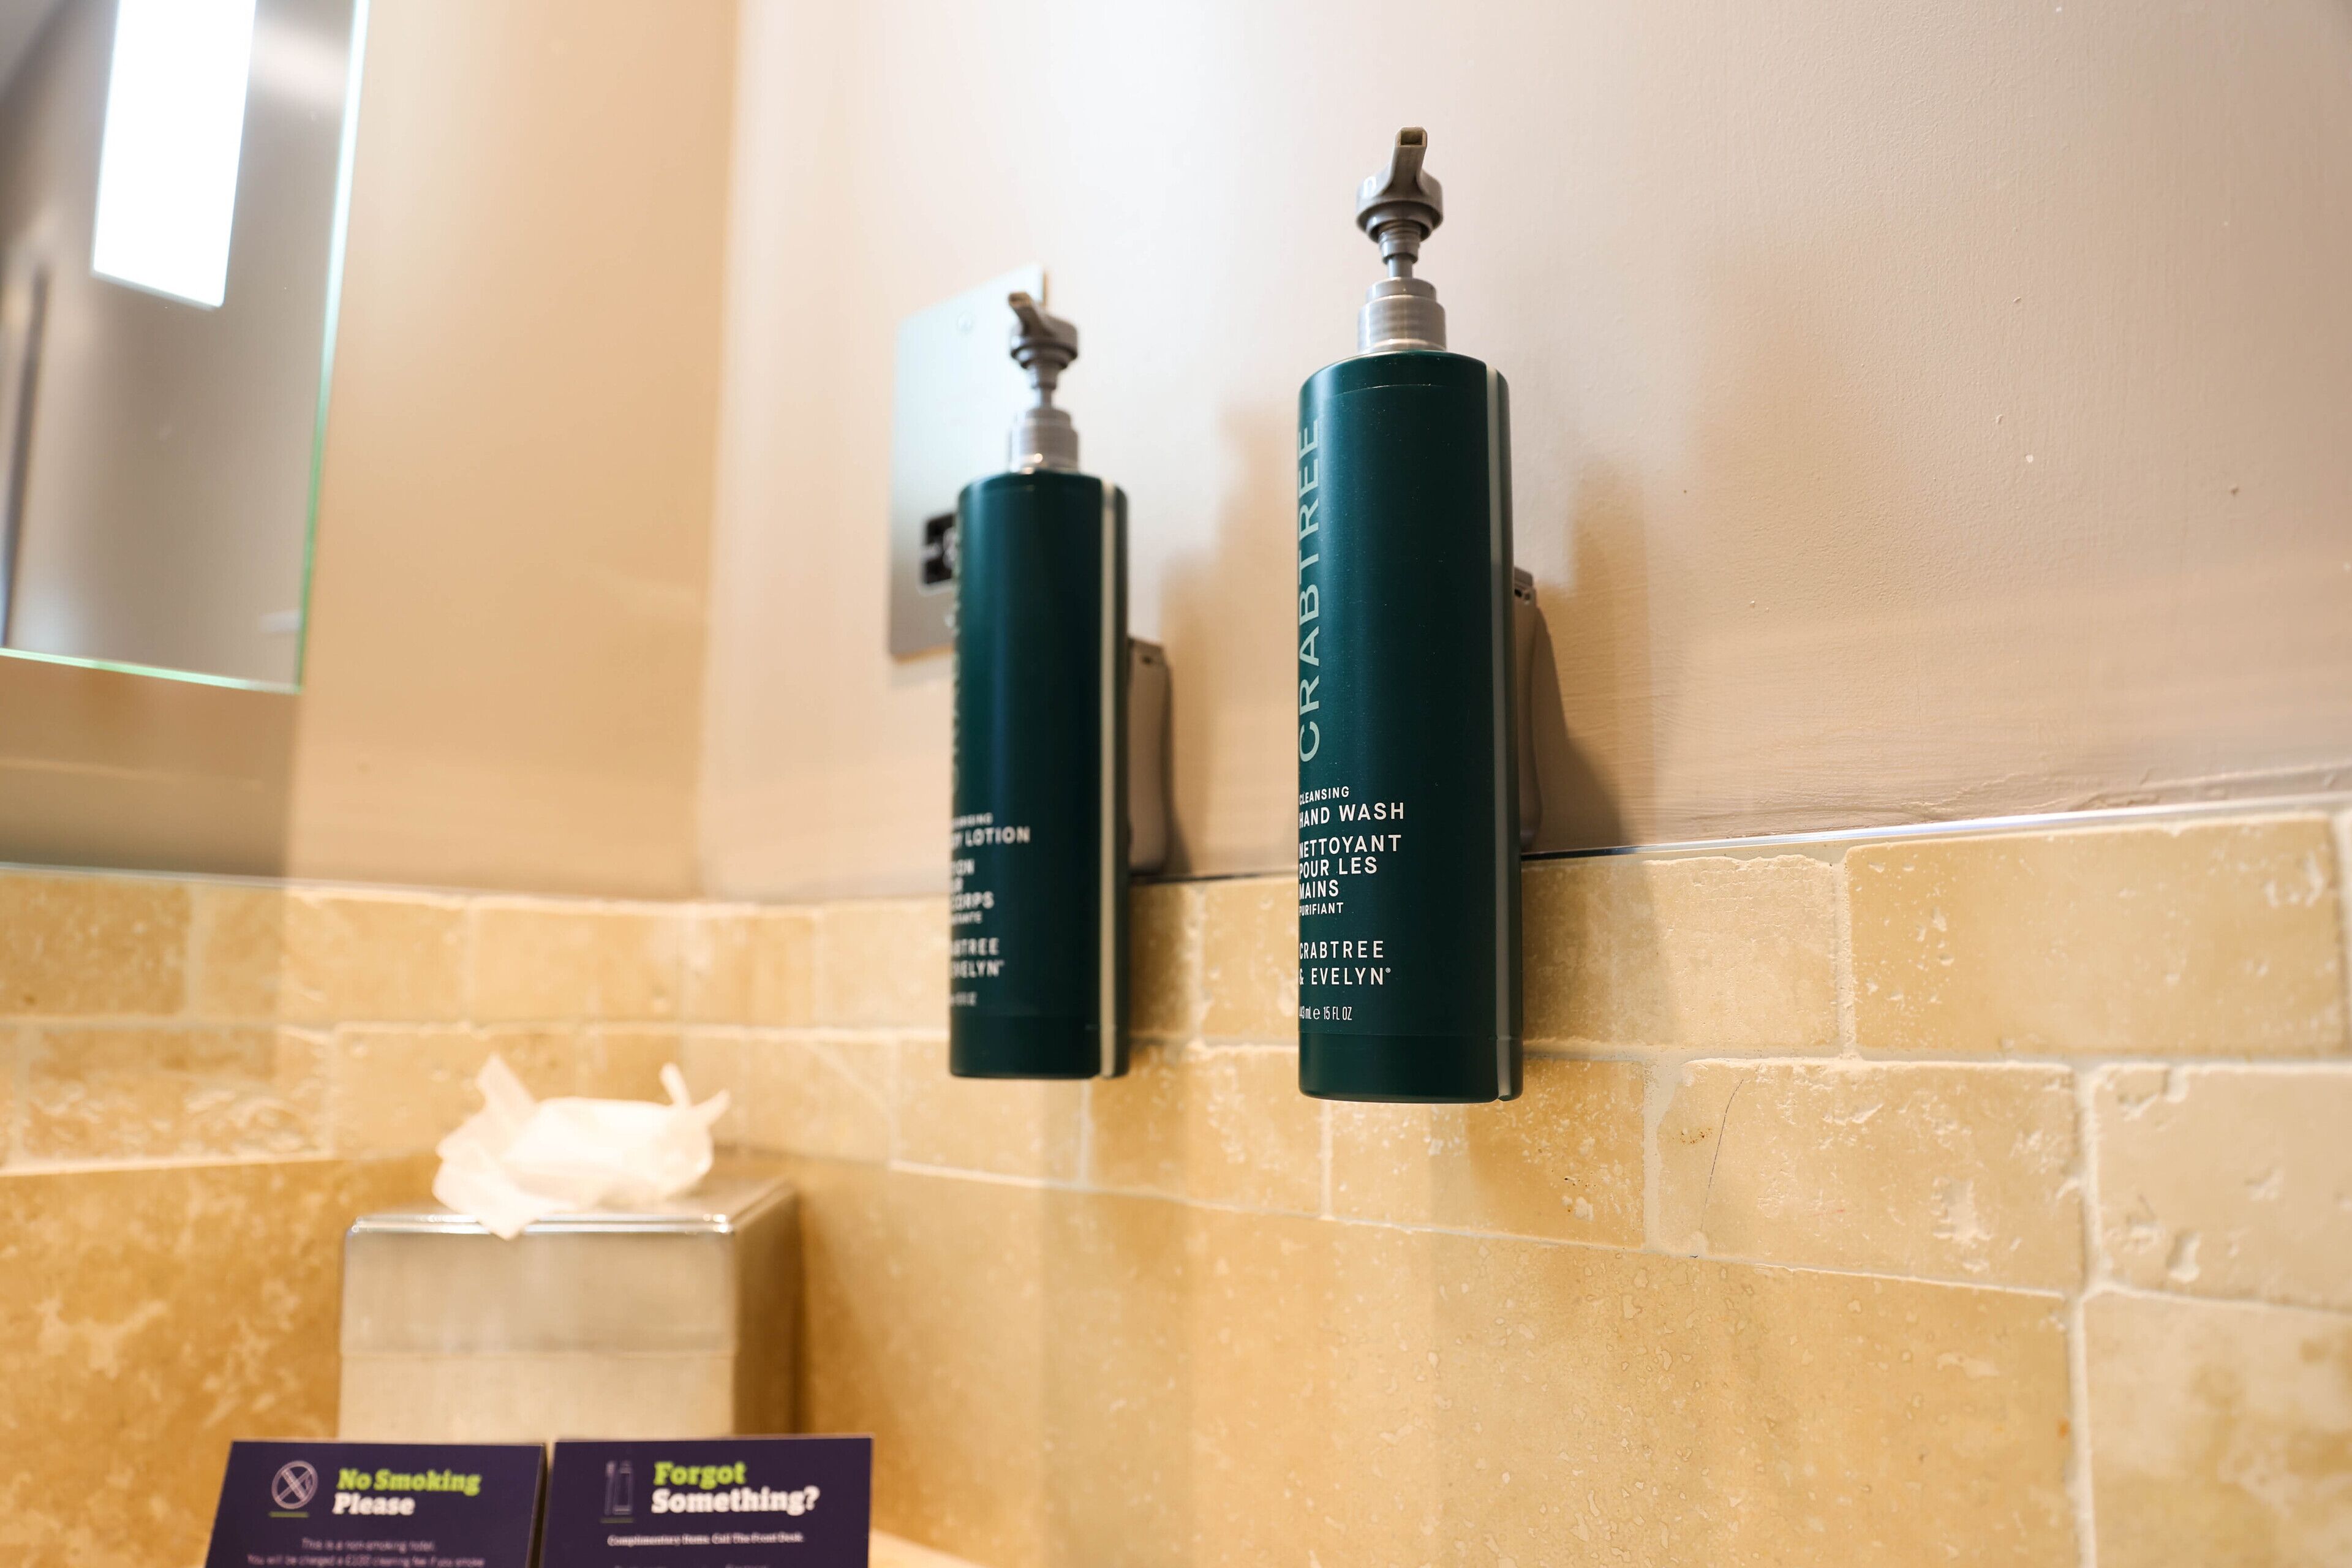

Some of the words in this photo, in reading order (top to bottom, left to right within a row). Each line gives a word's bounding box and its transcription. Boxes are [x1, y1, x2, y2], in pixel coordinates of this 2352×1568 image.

[1299, 419, 1320, 763] CRABTREE
[1299, 786, 1349, 805] CLEANSING
[1299, 807, 1330, 829] HAND
[1339, 802, 1404, 822] WASH
[965, 826, 1031, 847] LOTION
[1299, 834, 1401, 859] NETTOYANT
[1299, 859, 1330, 880] POUR
[1339, 856, 1378, 875] LES
[1299, 879, 1339, 900] MAINS
[1299, 902, 1344, 916] PURIFIANT
[1299, 941, 1384, 960] CRABTREE
[1323, 1006, 1330, 1020] 15
[1332, 1006, 1340, 1020] FL
[336, 1468, 372, 1490] No
[373, 1468, 482, 1496] Smoking
[654, 1461, 747, 1490] Forgot
[331, 1491, 416, 1515] Please
[652, 1486, 820, 1516] Something?
